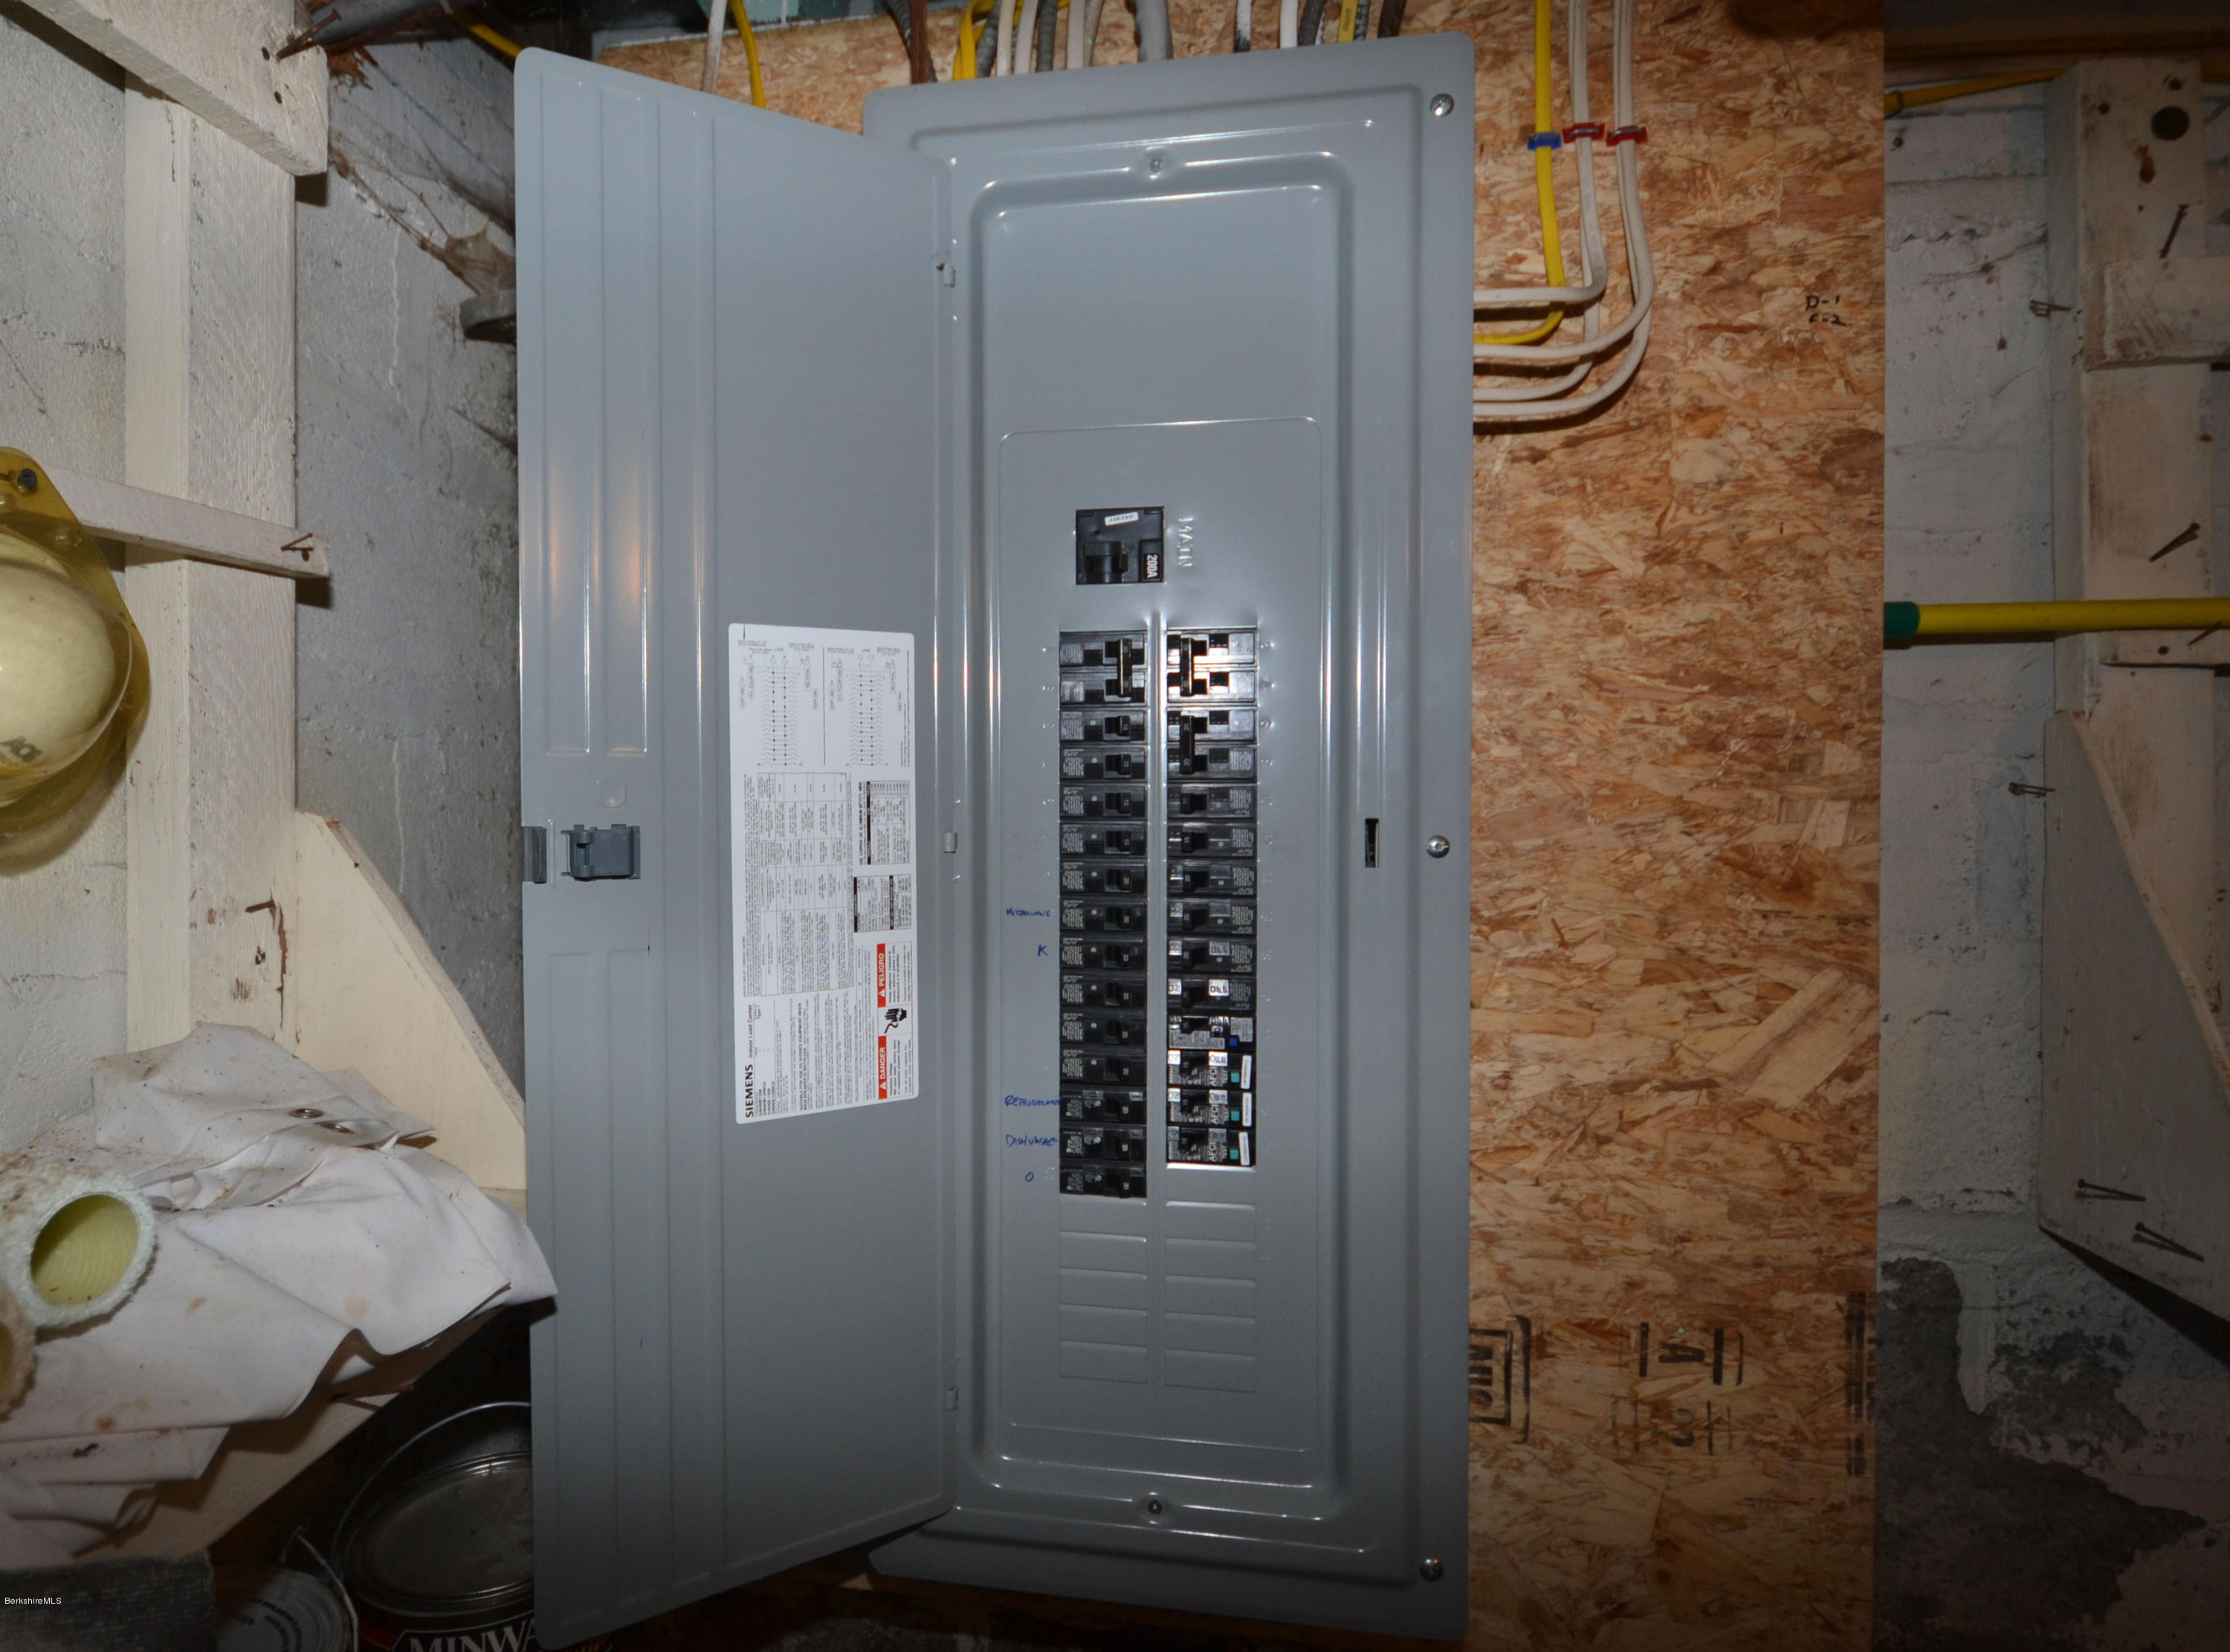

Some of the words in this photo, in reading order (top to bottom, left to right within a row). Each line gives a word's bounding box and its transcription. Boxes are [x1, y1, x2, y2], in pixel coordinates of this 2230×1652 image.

[1178, 517, 1194, 567] MAIN
[1147, 554, 1159, 578] 200A
[1038, 944, 1048, 957] K
[1209, 1066, 1218, 1086] AFCI
[745, 1064, 754, 1118] SIEMENS
[1209, 1142, 1217, 1162] AFCI
